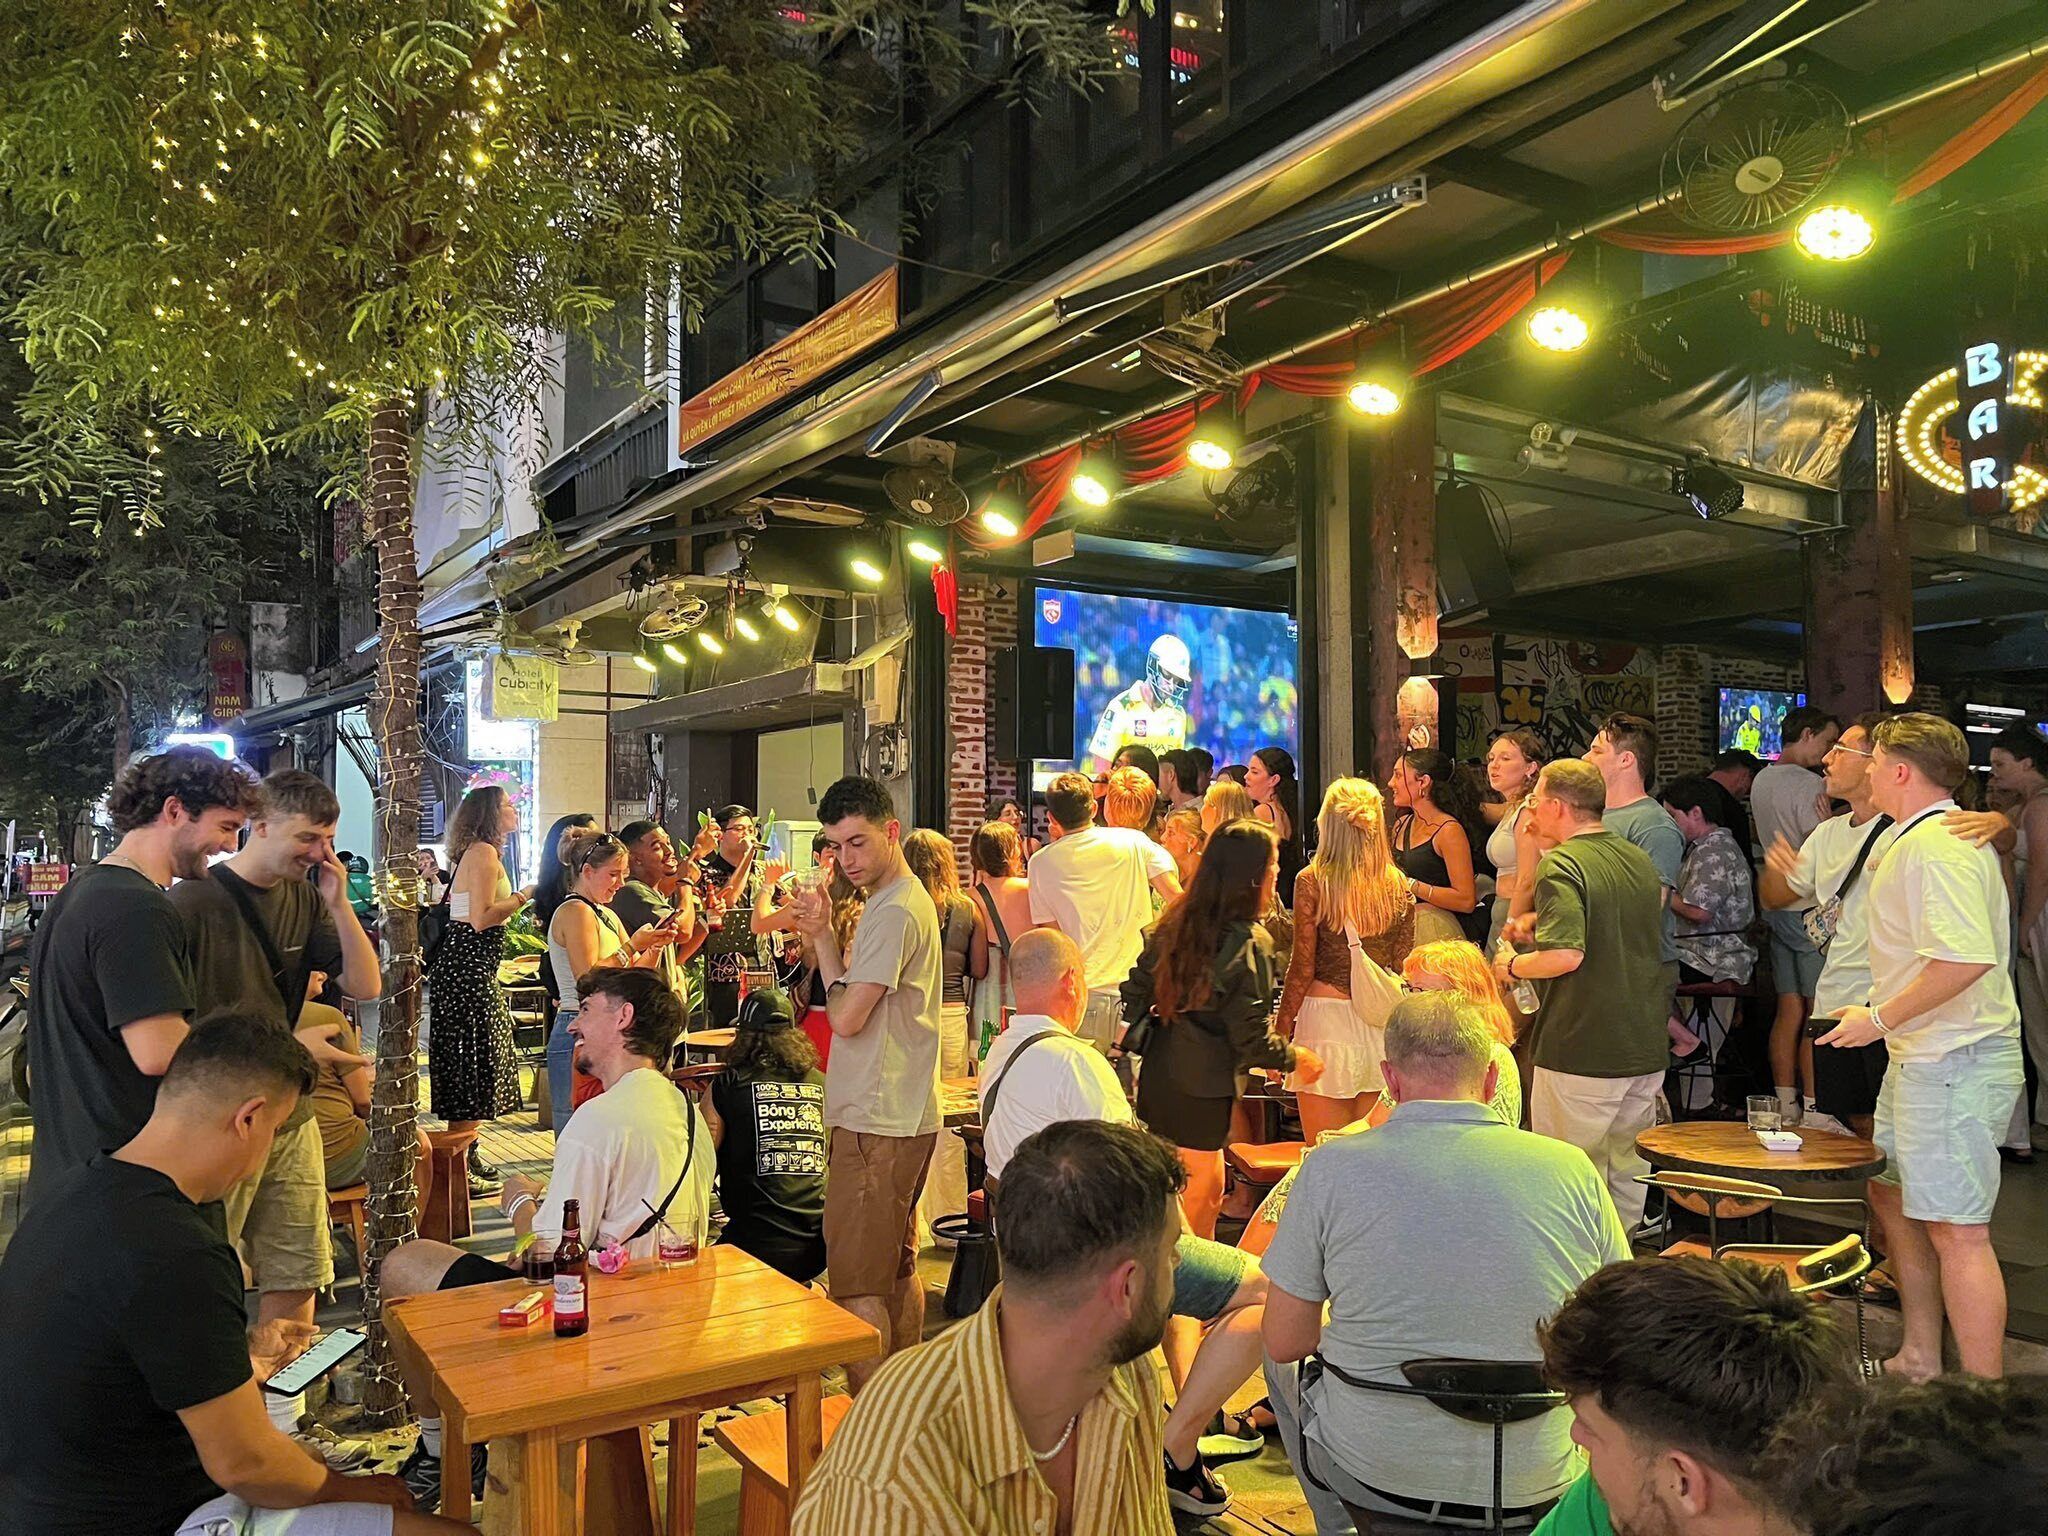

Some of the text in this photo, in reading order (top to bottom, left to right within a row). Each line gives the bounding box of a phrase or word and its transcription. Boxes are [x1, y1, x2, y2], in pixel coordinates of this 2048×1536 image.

[1821, 333, 1833, 345] BAR
[1965, 342, 2002, 489] BAR
[513, 669, 541, 677] Hotel
[499, 677, 551, 693] Cubicity
[214, 695, 241, 706] NAM
[755, 1083, 779, 1092] 100%
[758, 1103, 795, 1119] Bông
[759, 1118, 823, 1133] Experience
